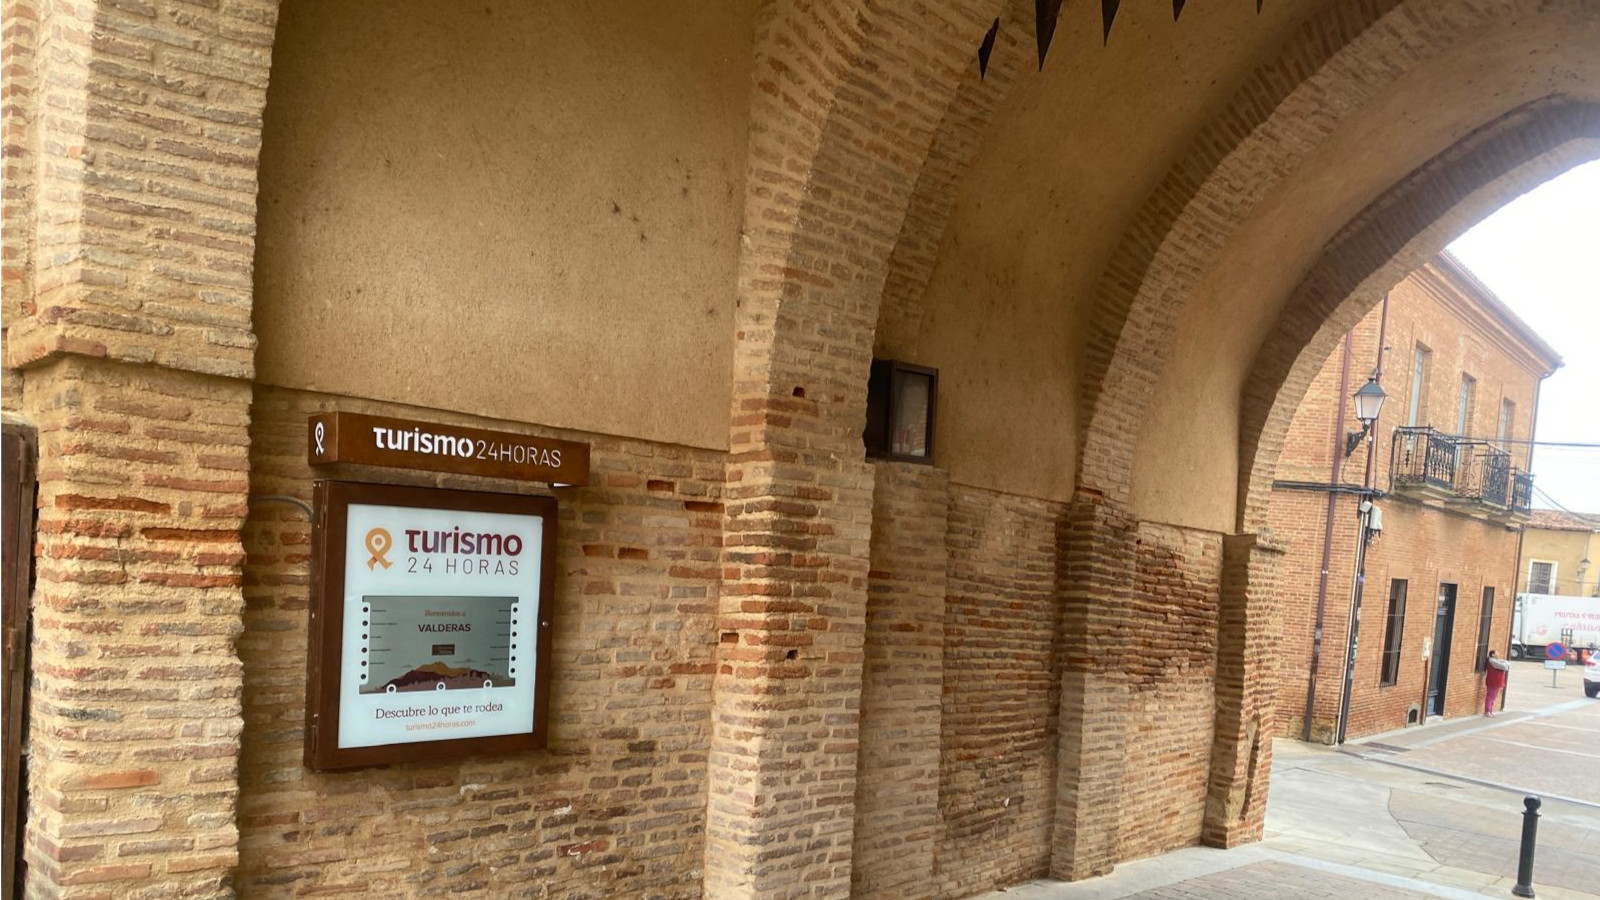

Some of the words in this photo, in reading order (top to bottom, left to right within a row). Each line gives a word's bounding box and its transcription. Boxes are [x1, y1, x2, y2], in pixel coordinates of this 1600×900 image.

[372, 426, 474, 459] turismo
[405, 525, 522, 557] turismo
[407, 556, 433, 574] 24
[446, 557, 519, 576] HORAS
[418, 623, 471, 633] VALDERAS
[375, 706, 426, 719] Descubre
[429, 705, 438, 716] lo
[441, 705, 460, 717] que
[463, 704, 472, 713] te
[475, 702, 503, 713] rodea
[405, 719, 476, 731] turismo24horas.com
